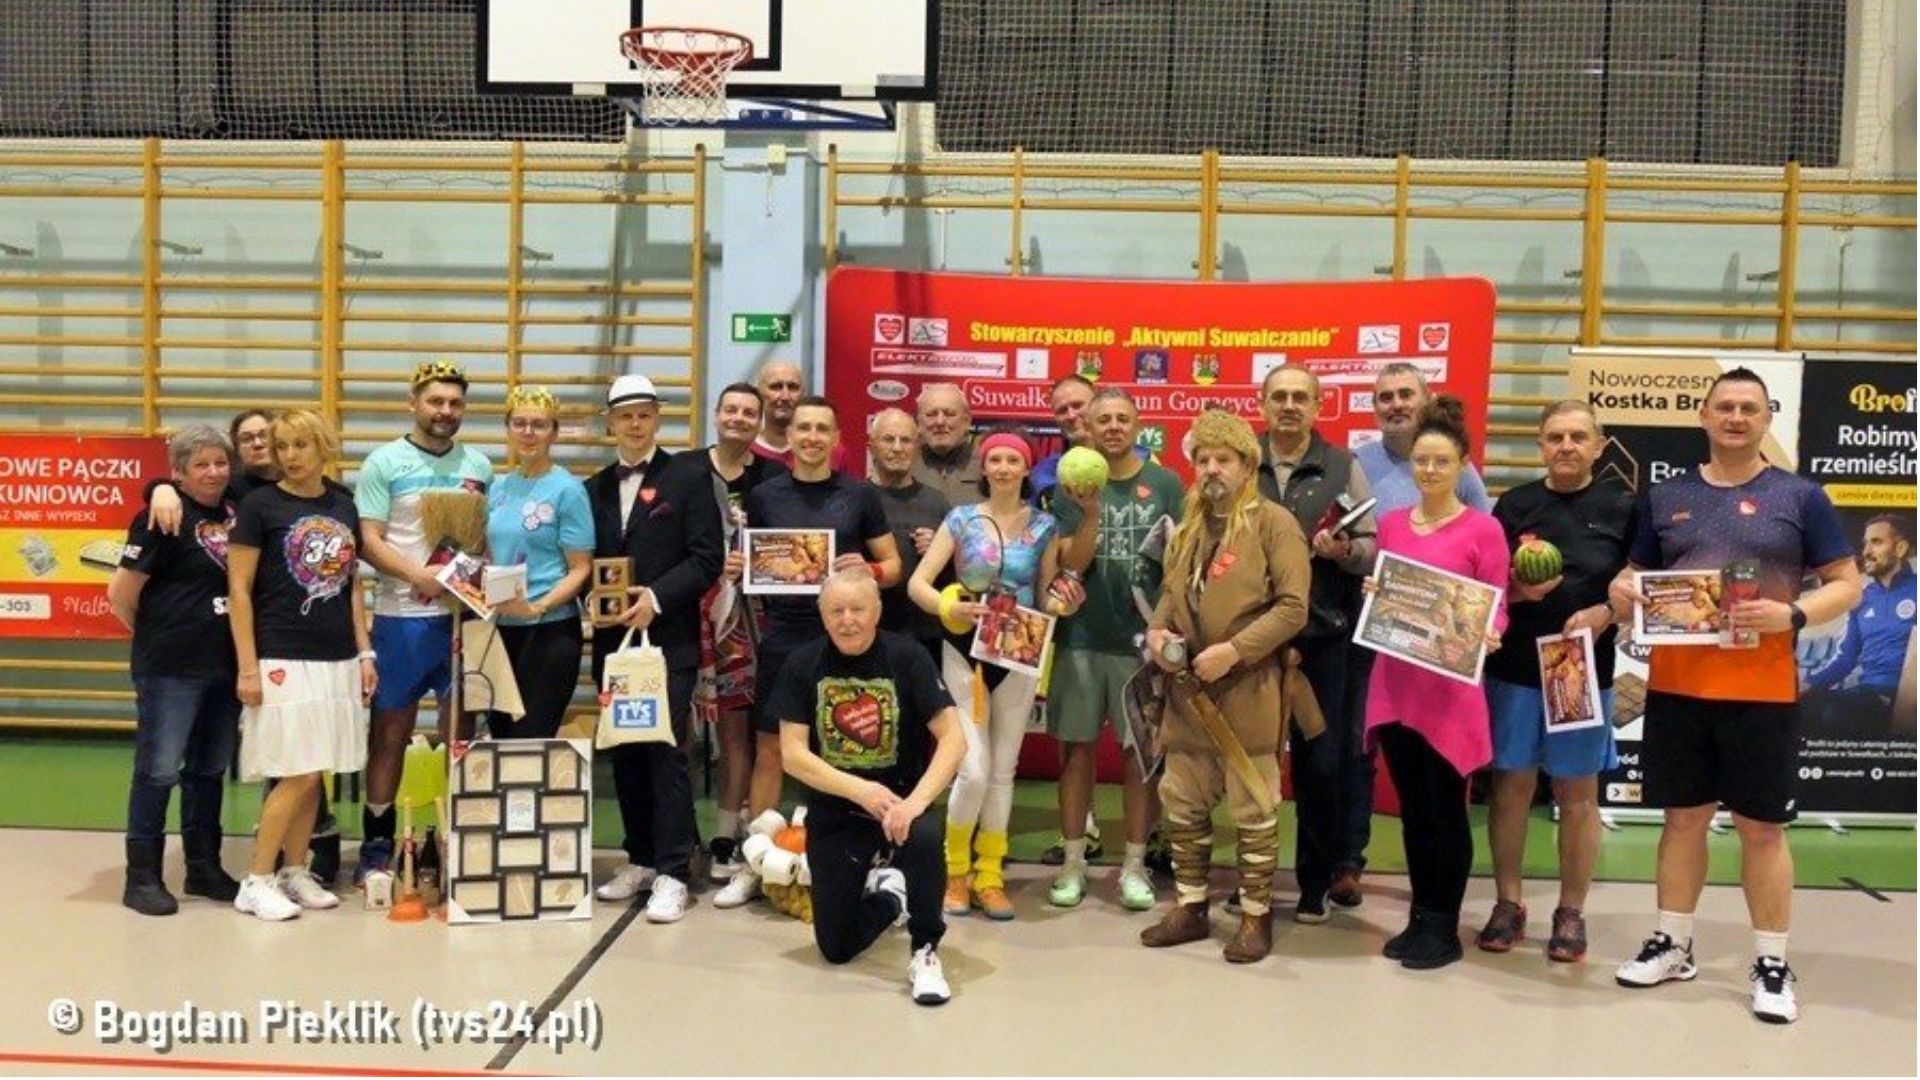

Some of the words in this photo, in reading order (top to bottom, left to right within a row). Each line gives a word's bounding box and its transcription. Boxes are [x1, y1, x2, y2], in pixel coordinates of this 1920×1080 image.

[970, 320, 1116, 345] Stowarzyszenie
[1122, 326, 1207, 348] „Aktywni
[1588, 391, 1669, 411] Kostka
[1838, 424, 1917, 452] Robimy
[57, 457, 142, 484] PĄCZKI
[14, 510, 43, 522] INNE
[46, 510, 97, 522] WYPIEKI
[305, 536, 343, 563] 34
[62, 595, 117, 618] Nalb
[616, 700, 651, 720] TVS
